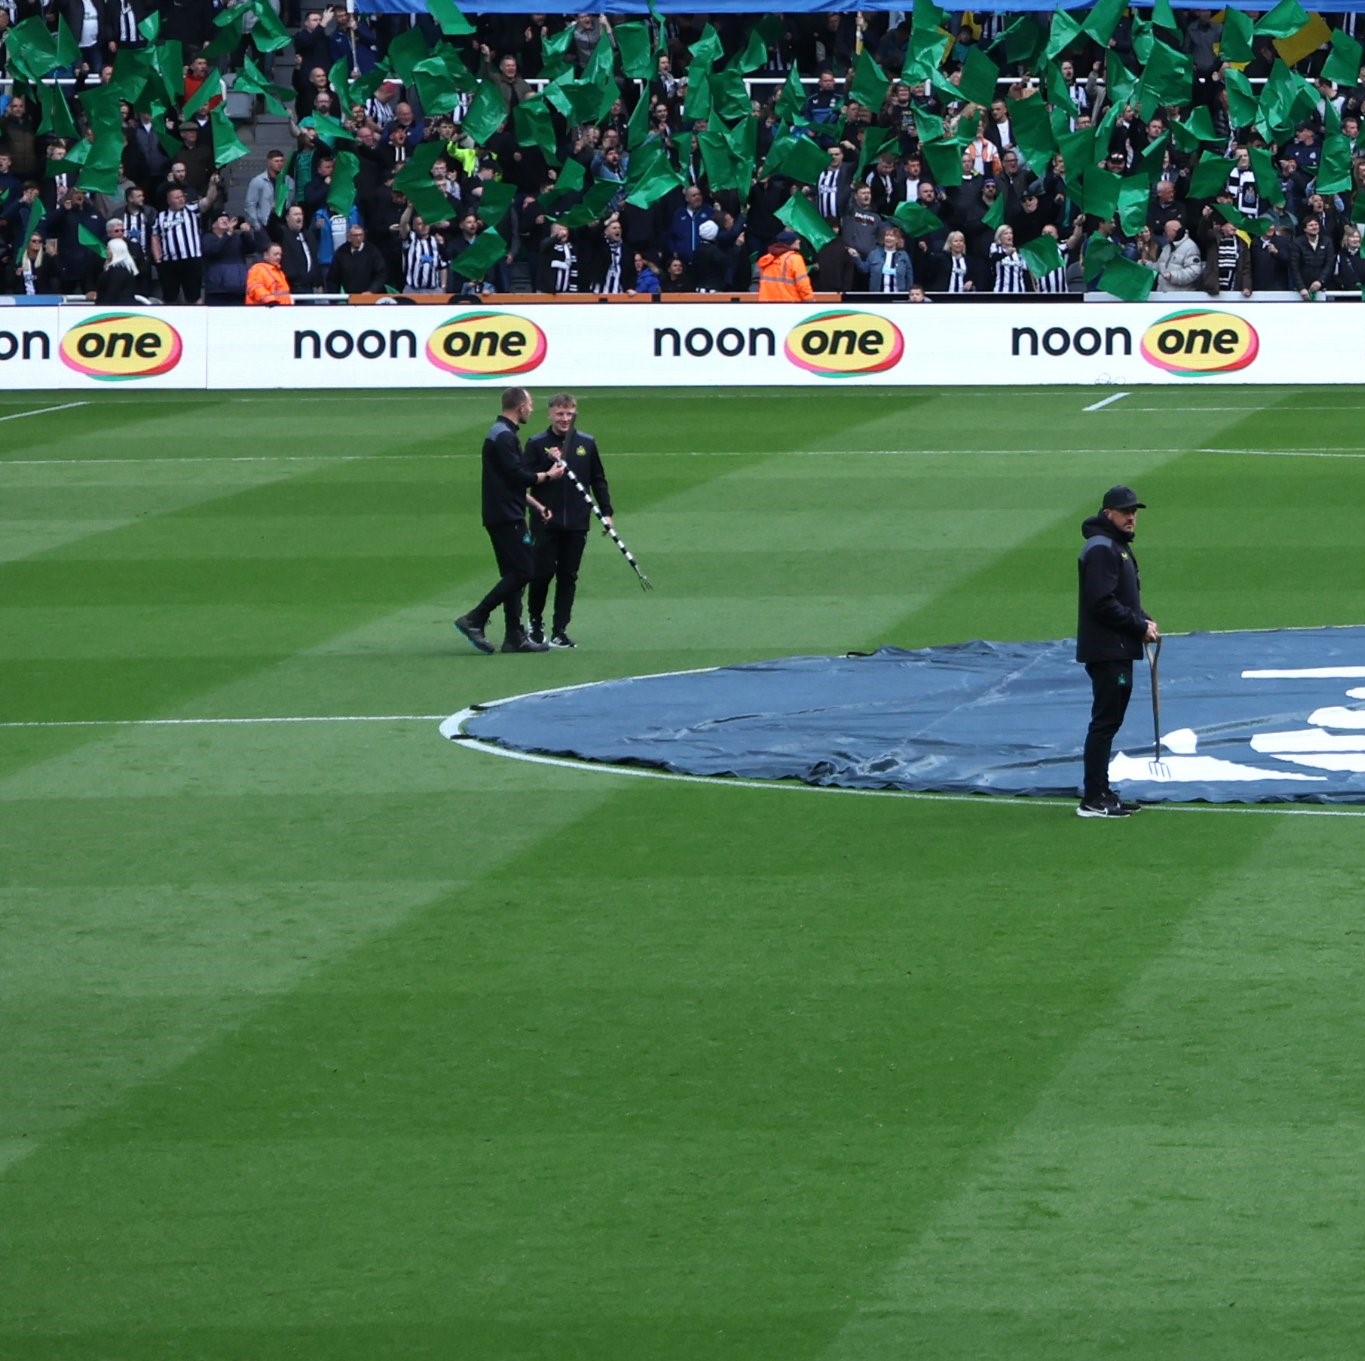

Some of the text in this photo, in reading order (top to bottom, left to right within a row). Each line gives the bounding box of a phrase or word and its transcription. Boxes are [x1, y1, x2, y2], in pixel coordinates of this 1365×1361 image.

[78, 332, 162, 360] one
[294, 329, 526, 359] noon one
[654, 327, 884, 357] noon one
[1012, 326, 1239, 356] noon one
